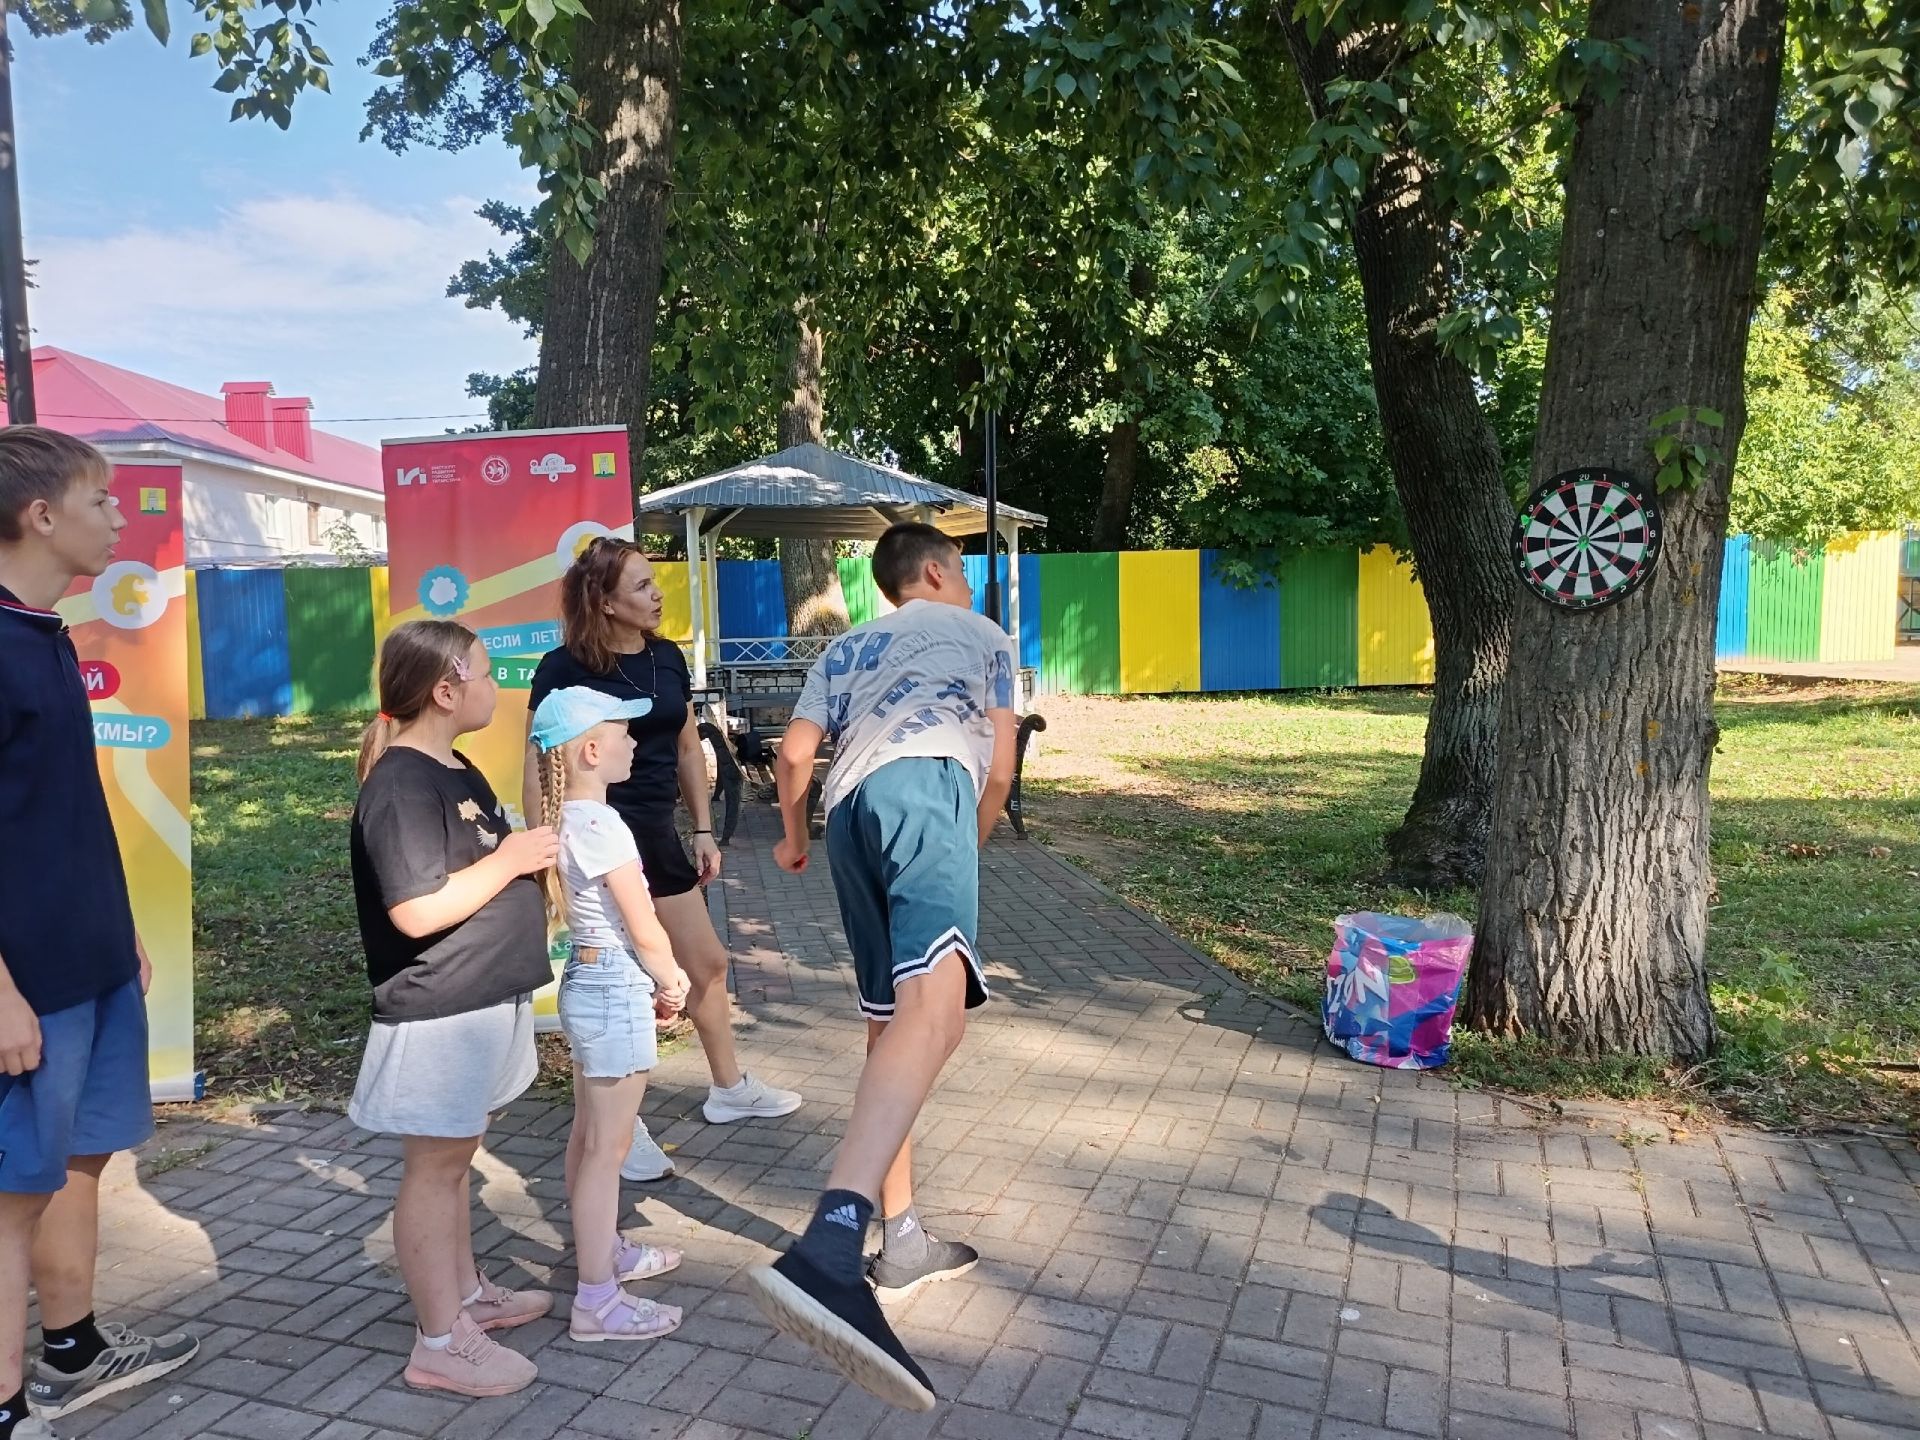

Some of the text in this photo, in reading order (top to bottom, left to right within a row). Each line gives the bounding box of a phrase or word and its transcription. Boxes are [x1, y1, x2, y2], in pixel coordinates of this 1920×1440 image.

[482, 629, 561, 649] ЕСЛИ ЛЕТ
[497, 667, 508, 680] В
